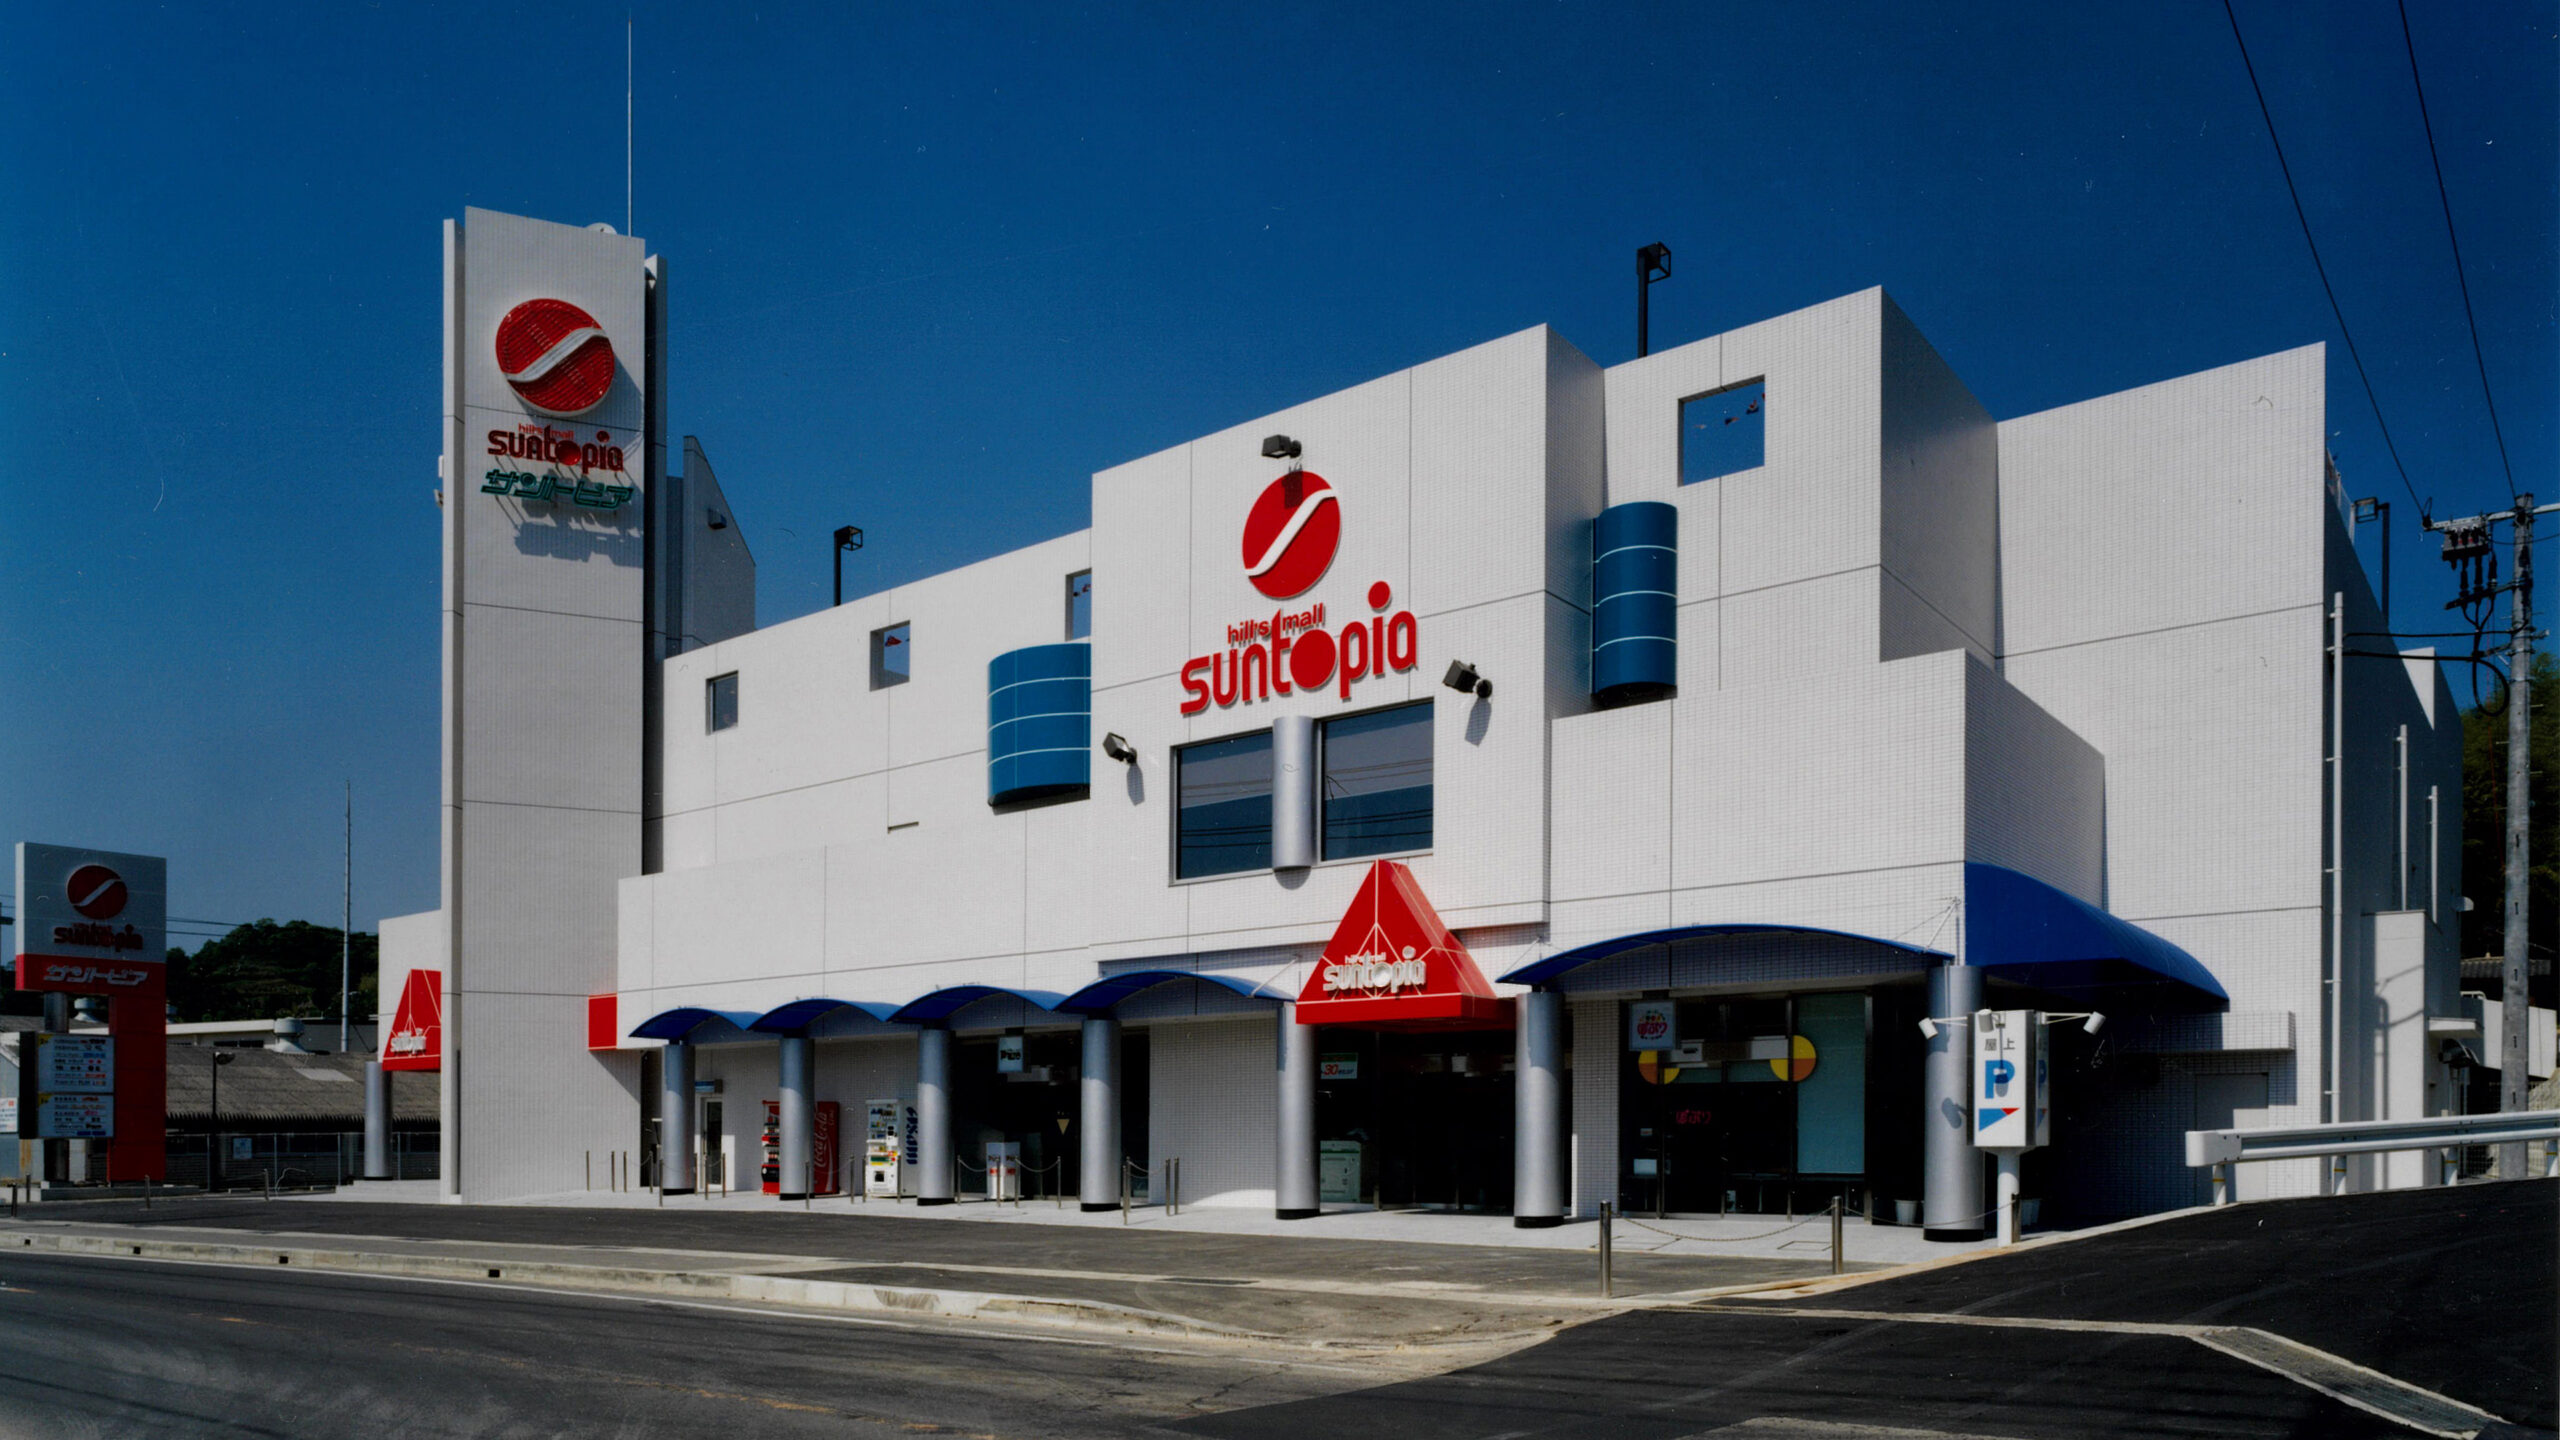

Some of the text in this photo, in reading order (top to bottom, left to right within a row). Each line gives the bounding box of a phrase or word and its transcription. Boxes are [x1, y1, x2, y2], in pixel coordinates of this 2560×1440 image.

[487, 424, 624, 475] suntopia
[1282, 602, 1324, 631] mall
[1180, 580, 1418, 715] suntopia
[1322, 945, 1427, 994] suntopia
[1984, 1037, 2016, 1052] 屋上
[1984, 1059, 2015, 1099] P
